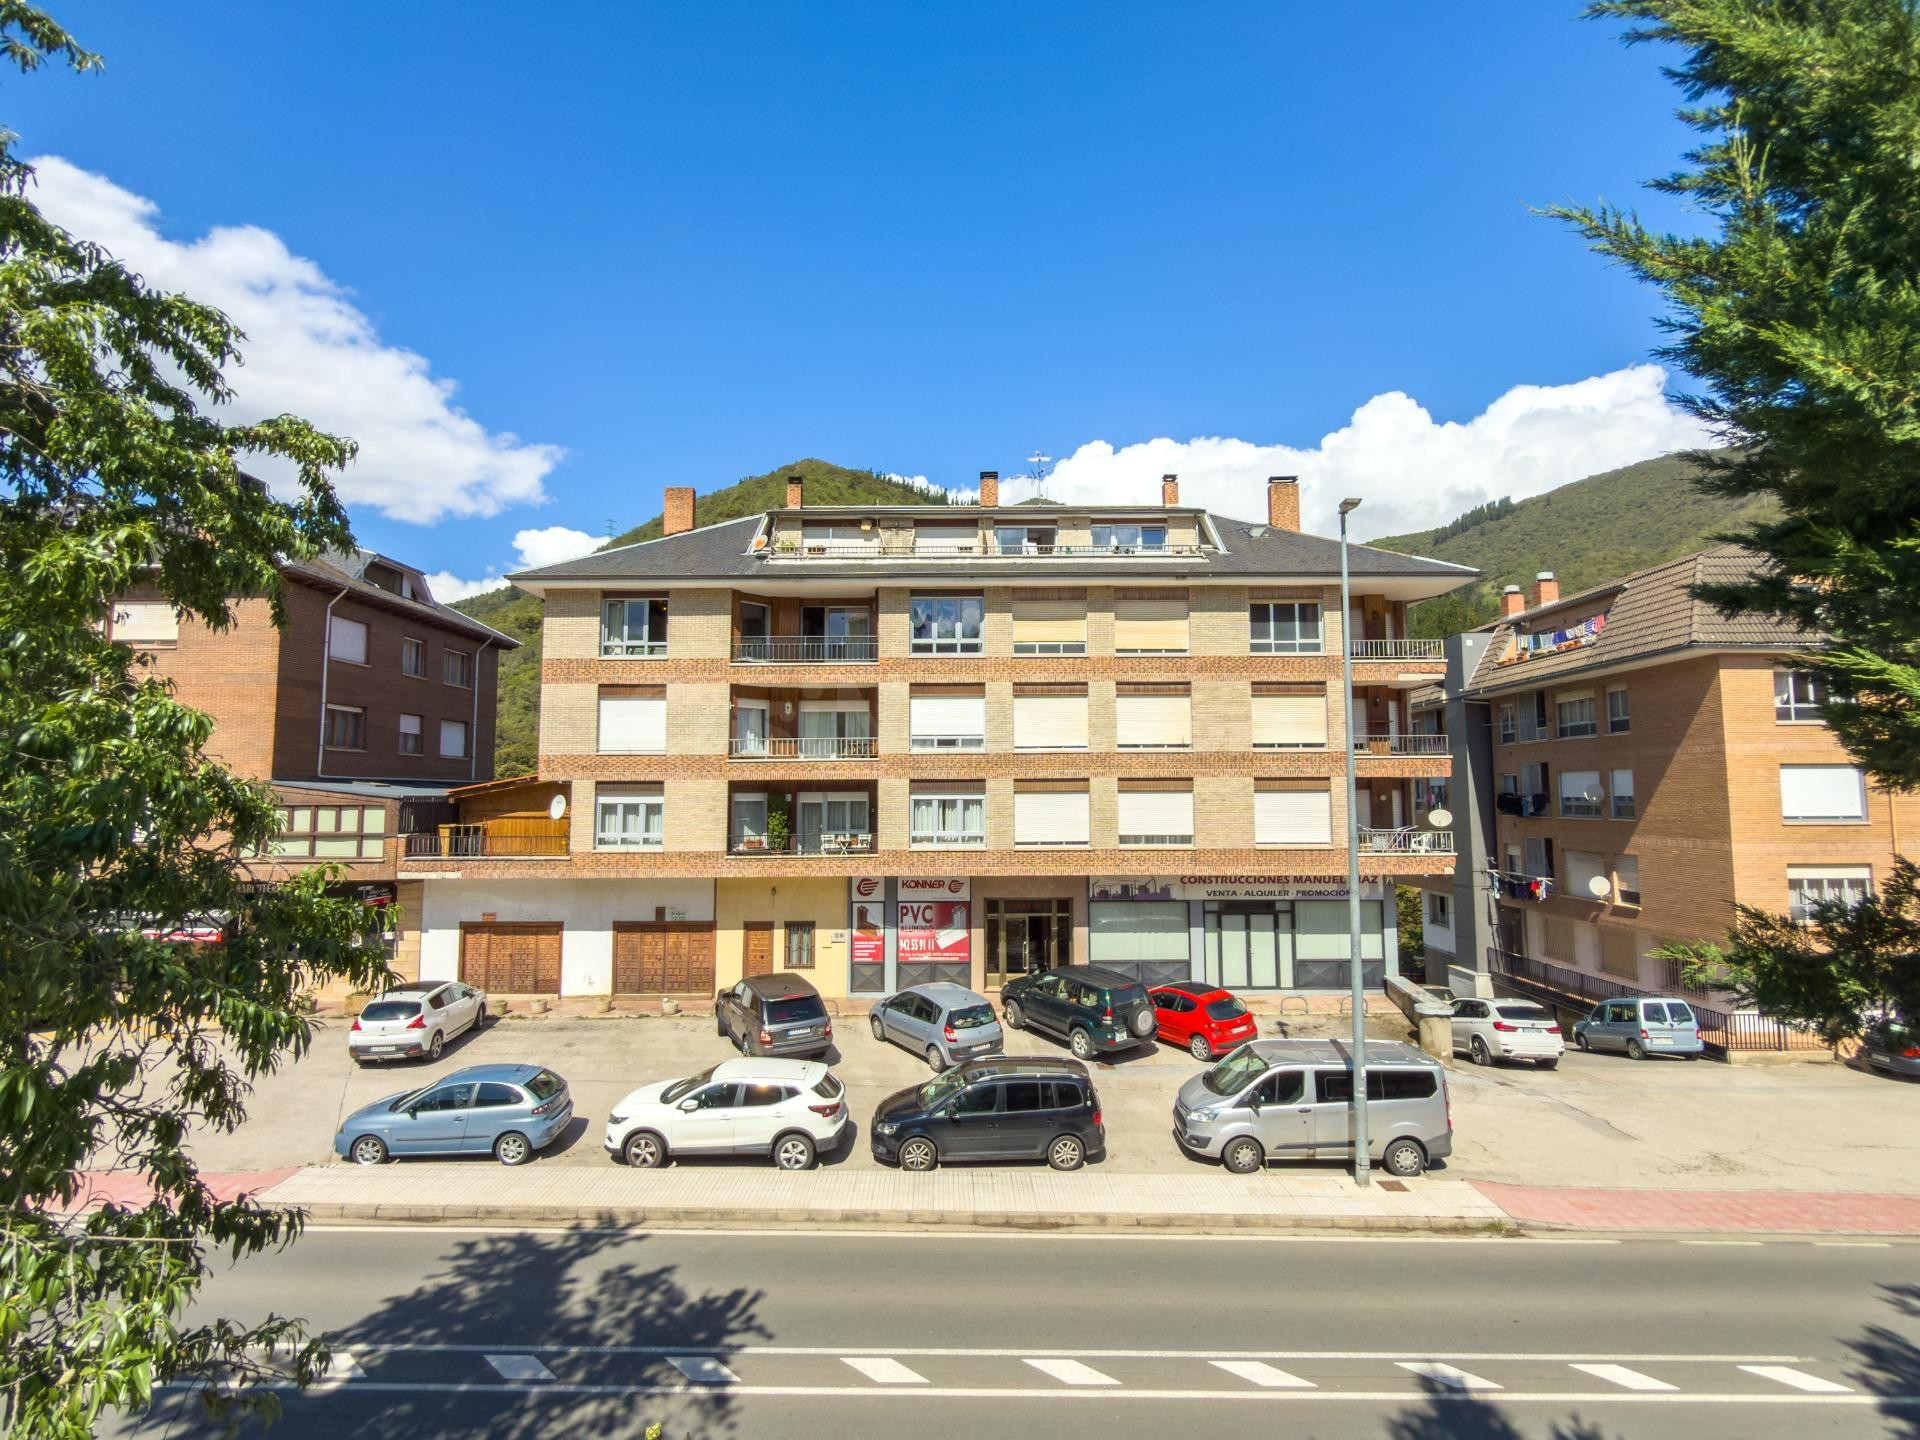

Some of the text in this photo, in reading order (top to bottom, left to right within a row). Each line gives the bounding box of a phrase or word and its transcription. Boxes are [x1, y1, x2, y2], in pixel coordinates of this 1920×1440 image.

[901, 879, 945, 889] KONNER
[1181, 875, 1378, 885] CONSTRUCCIONES MANUEL IAZ
[1206, 889, 1238, 897] VENTA
[1244, 889, 1290, 897] ALQUILER
[900, 904, 934, 924] PVC
[900, 925, 934, 933] ALUMINIO
[899, 938, 910, 951] 942
[911, 938, 919, 951] 55
[919, 938, 927, 951] 91
